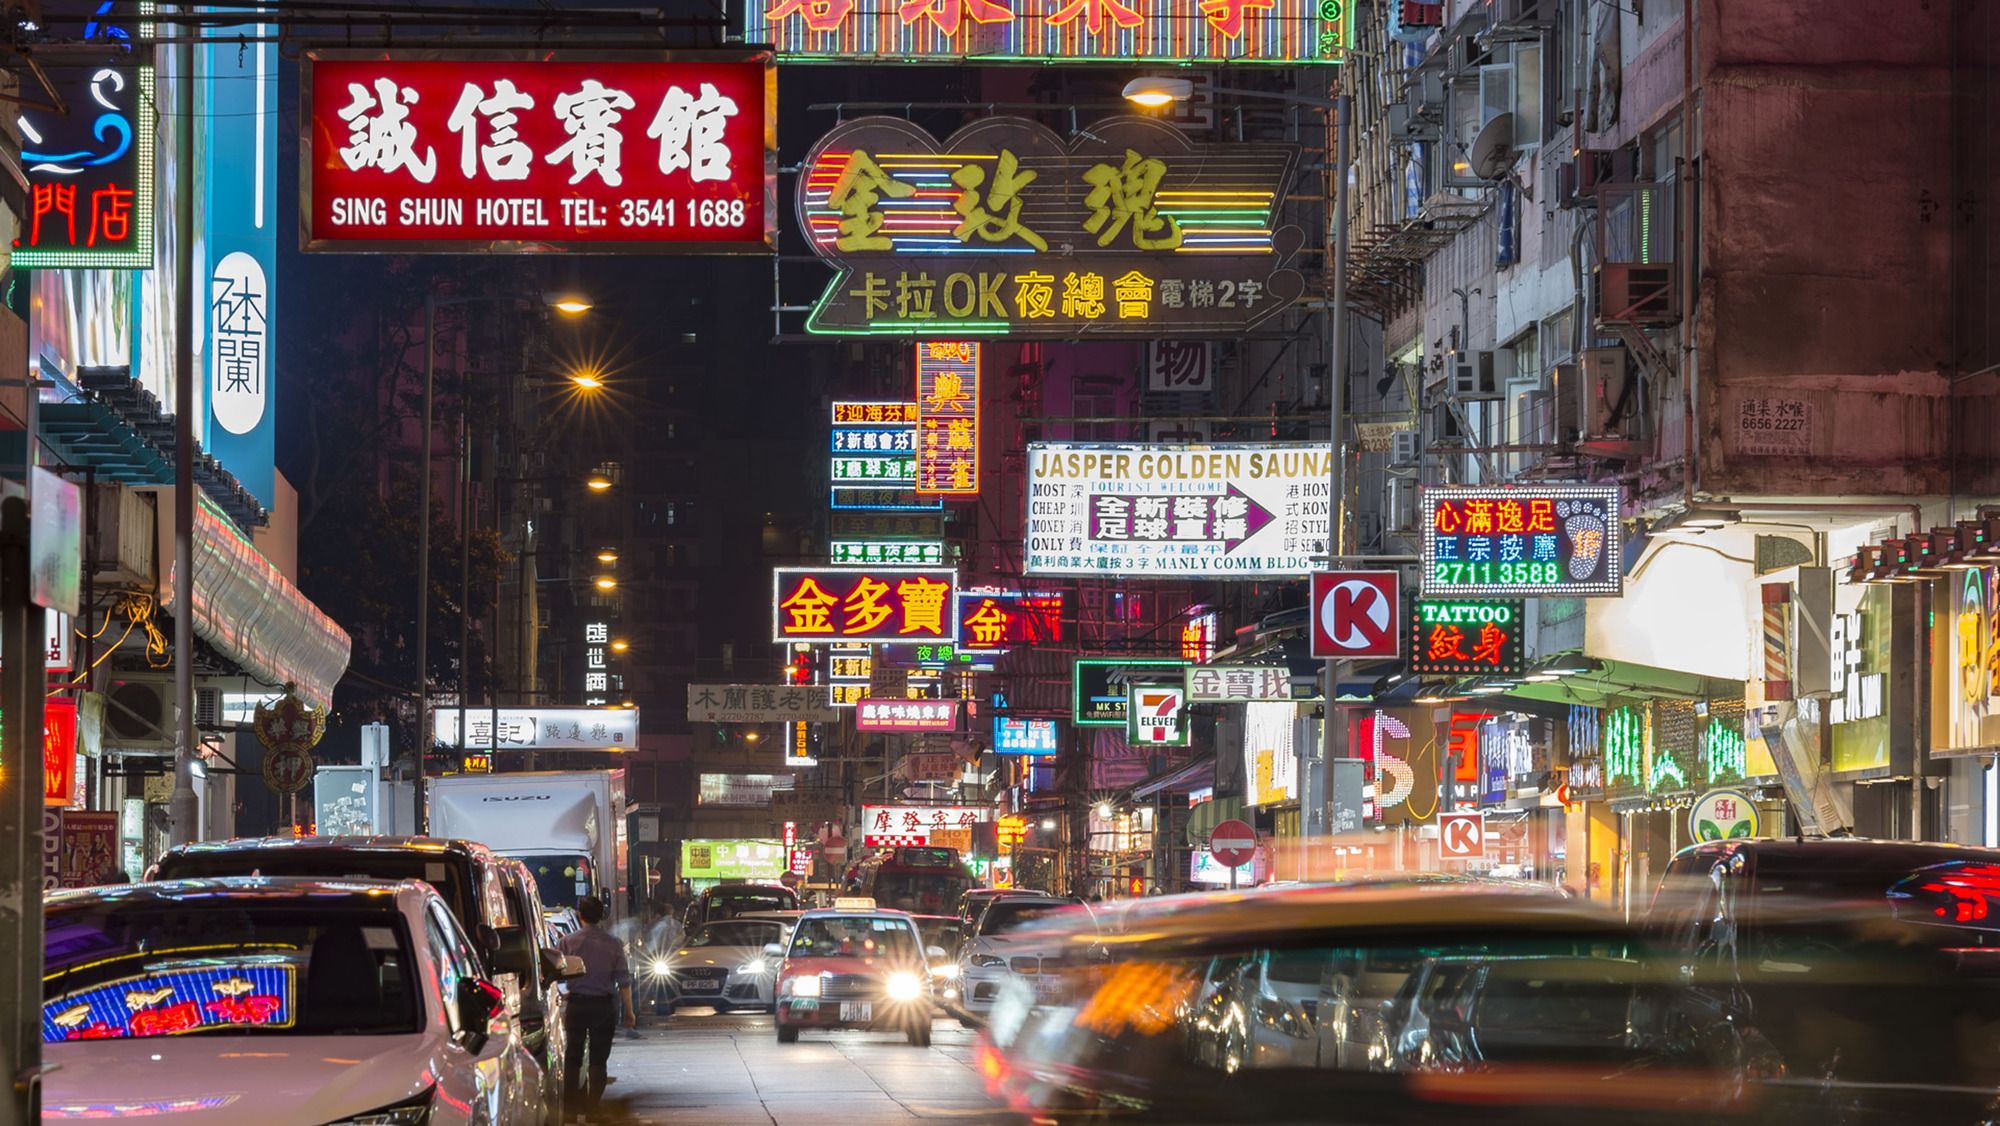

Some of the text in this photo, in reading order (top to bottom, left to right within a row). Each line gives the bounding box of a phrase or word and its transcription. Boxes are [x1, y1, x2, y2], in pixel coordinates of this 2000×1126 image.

[338, 77, 739, 187] 誠信賓館
[828, 148, 1184, 252] 金玫瑰
[31, 183, 134, 247] 門店
[331, 198, 746, 227] SING SHUN HOTEL TEL: 3541 1688
[1742, 417, 1805, 430] 6656 2227
[1035, 453, 1130, 479] JASPER
[1138, 453, 1241, 480] GOLDEN
[1032, 483, 1066, 497] MOST
[1089, 482, 1223, 492] TOURIST WELCOME
[1302, 483, 1329, 496] HON
[1032, 501, 1066, 515] CHEAP
[1096, 496, 1249, 518] 全新裝修
[1302, 502, 1329, 515] KON
[1031, 519, 1065, 533] MONEY
[1096, 518, 1248, 540] 足球直播
[1301, 520, 1329, 533] STYL
[1031, 537, 1065, 551] ONLY
[1155, 557, 1209, 570] MANLY
[1214, 557, 1262, 570] COMM
[1267, 557, 1308, 570] BLDG
[1434, 562, 1491, 584] 2711
[780, 576, 949, 635] 金多寶
[1423, 606, 1510, 622] TATTOO
[1427, 621, 1507, 664] 紋身
[1191, 669, 1290, 699] 金寶找
[1096, 702, 1127, 711] MK ST
[469, 721, 525, 744] 喜記
